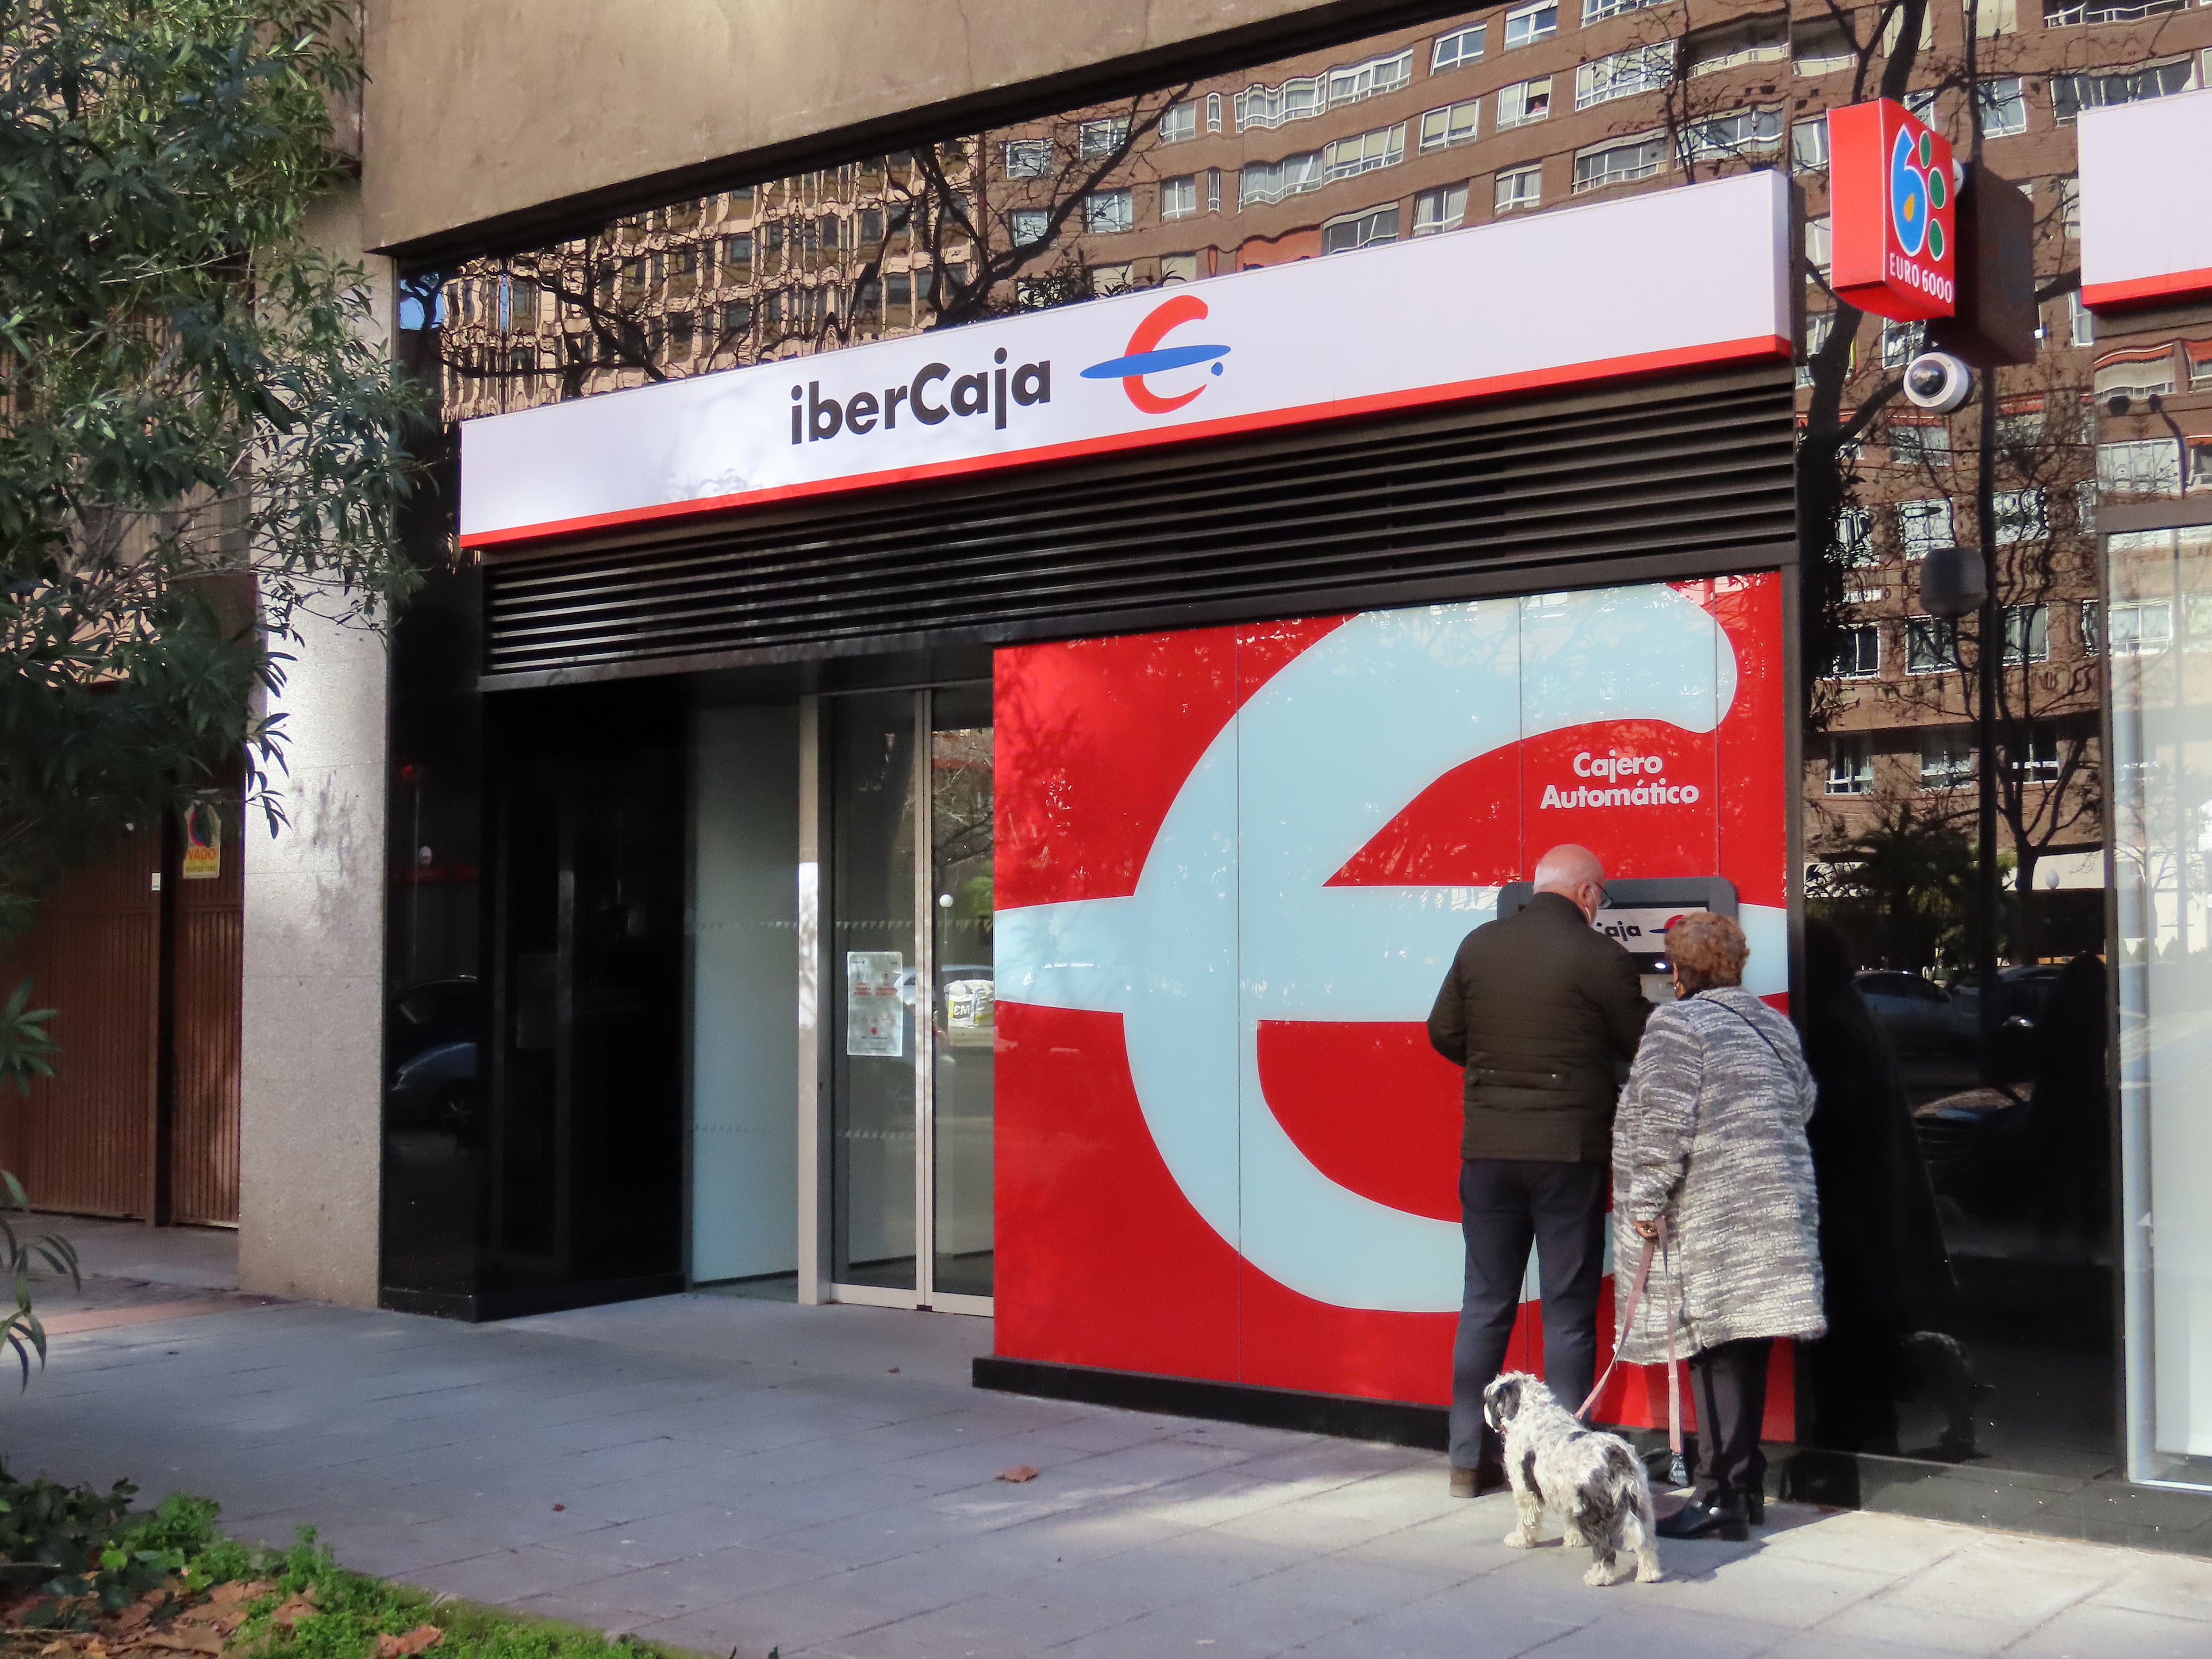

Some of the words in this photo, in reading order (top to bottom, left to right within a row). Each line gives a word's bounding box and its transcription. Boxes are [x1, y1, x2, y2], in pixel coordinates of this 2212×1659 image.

[1889, 252, 1919, 288] EURO
[1921, 270, 1952, 303] 6000
[791, 347, 1051, 445] iberCaja
[1573, 749, 1663, 783] Cajero
[1540, 778, 1699, 809] Automático
[188, 848, 215, 860] VADO
